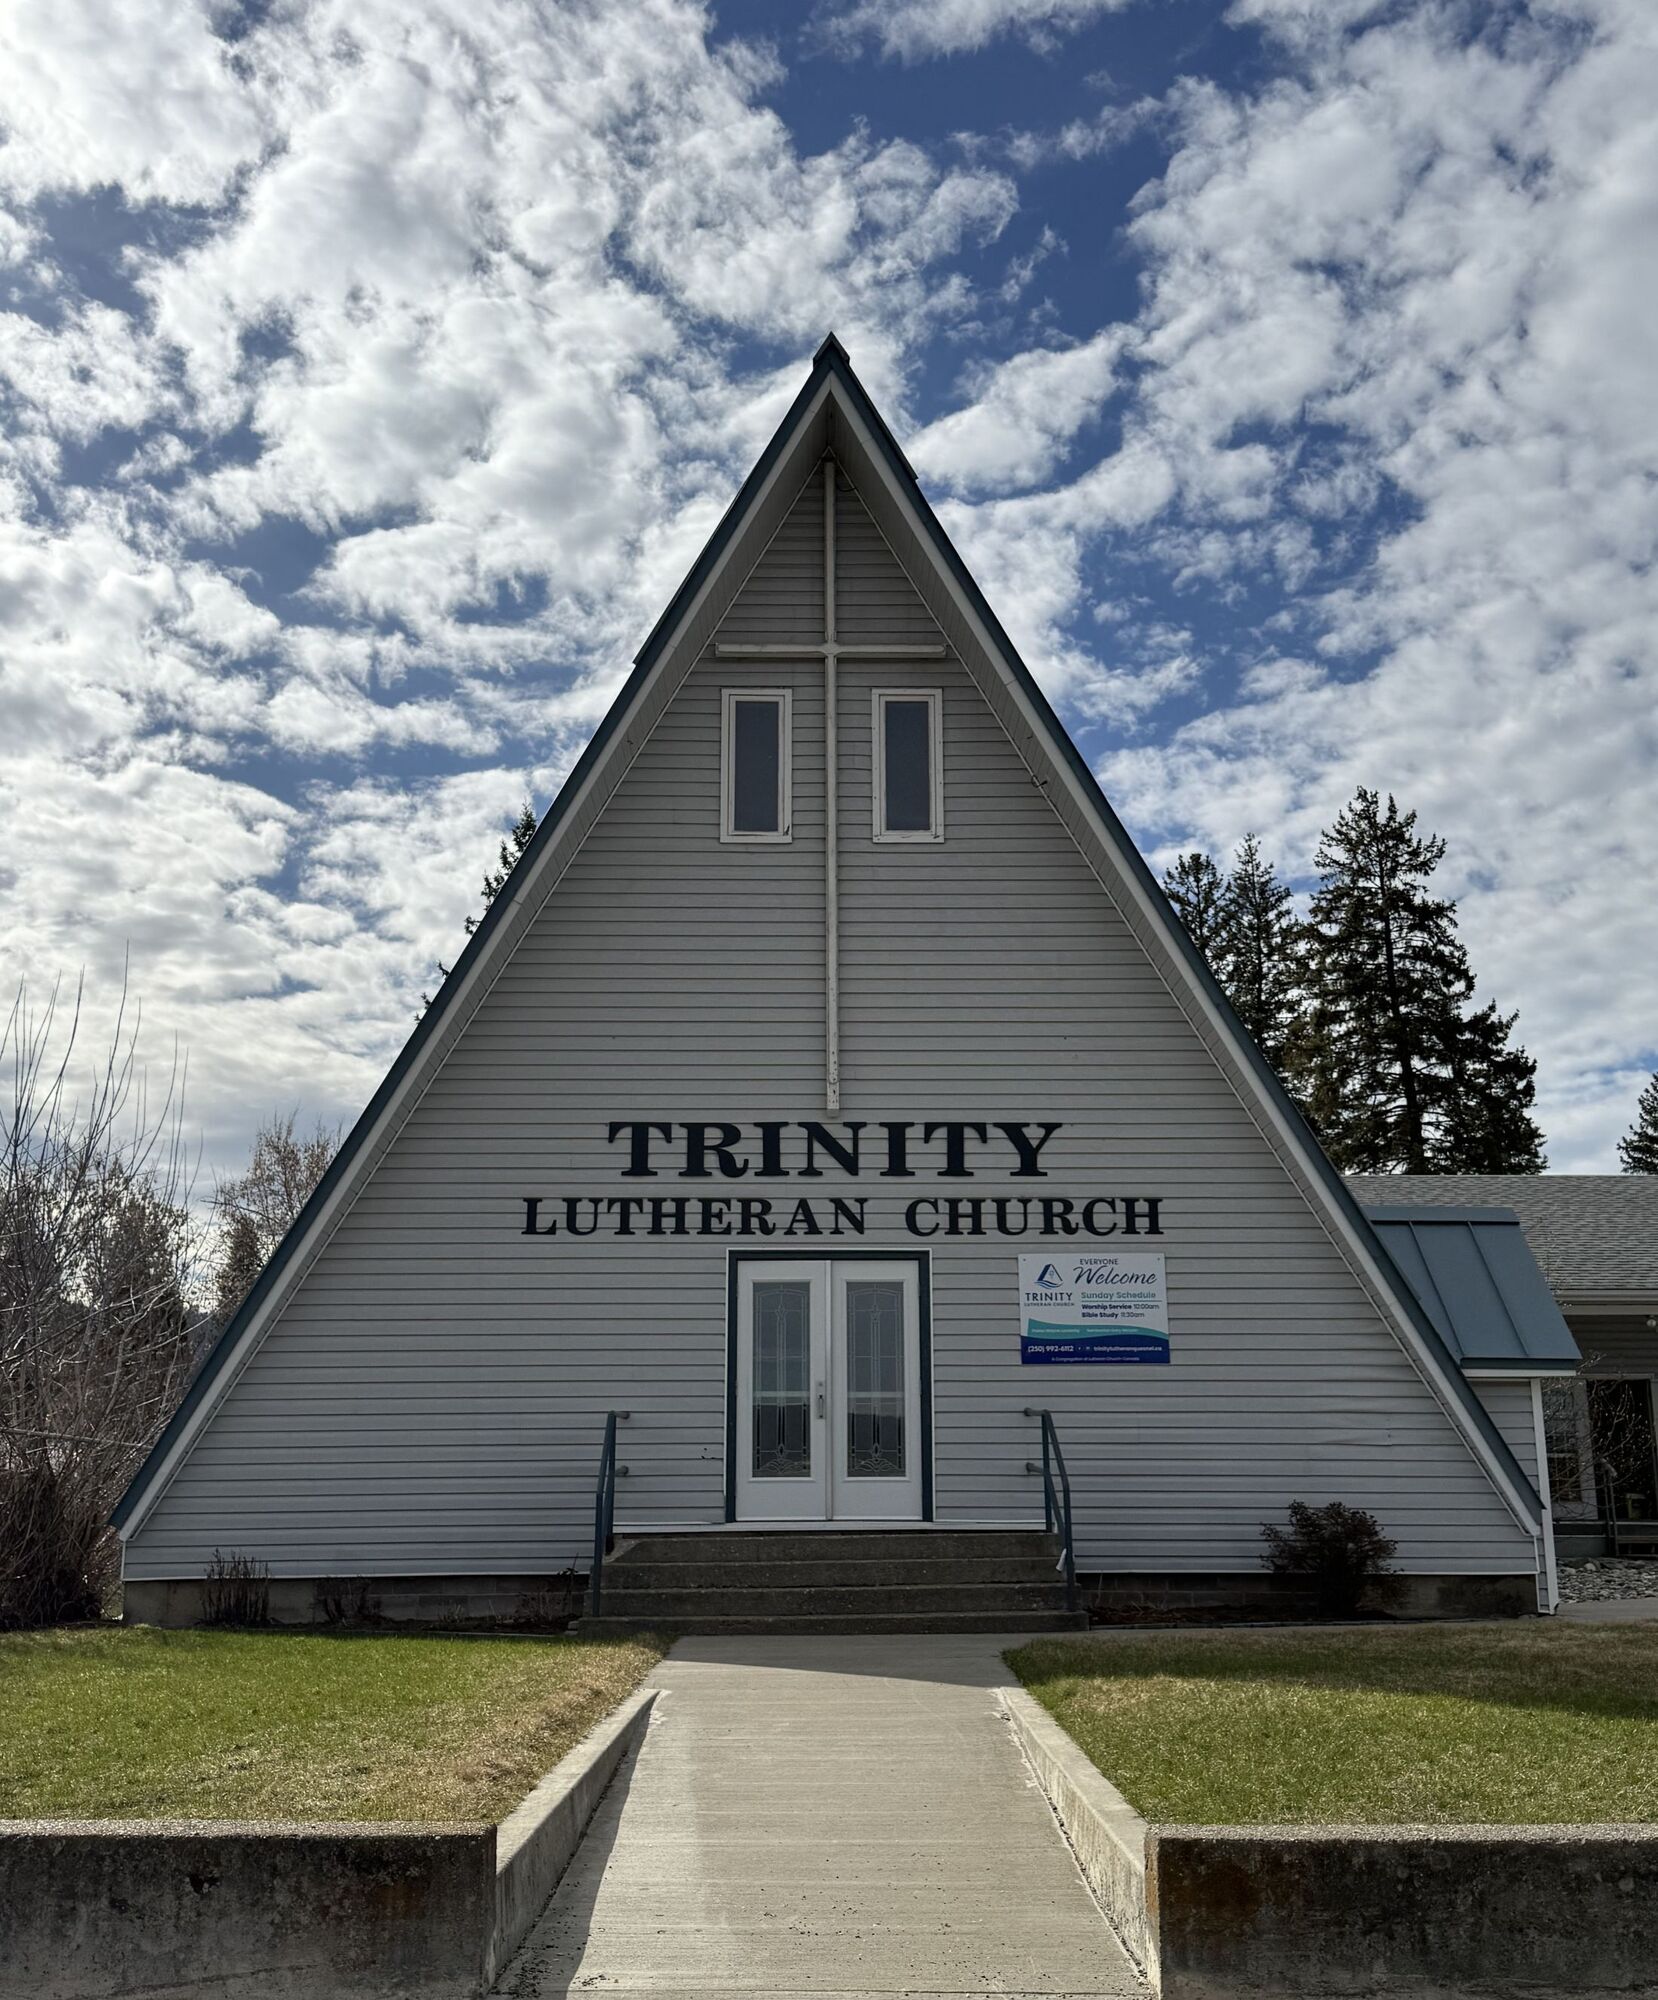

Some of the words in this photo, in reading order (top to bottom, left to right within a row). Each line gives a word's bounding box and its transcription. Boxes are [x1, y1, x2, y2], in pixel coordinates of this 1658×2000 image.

[608, 1122, 1063, 1177] TRINITY
[521, 1198, 869, 1236] LUTHERAN
[904, 1198, 1165, 1237] CHURCH
[1073, 1265, 1158, 1284] Welcome
[1025, 1292, 1073, 1301] TRINITY
[1081, 1292, 1114, 1300] Sunday
[1116, 1291, 1157, 1299] Schedule
[1027, 1345, 1045, 1353] (250)
